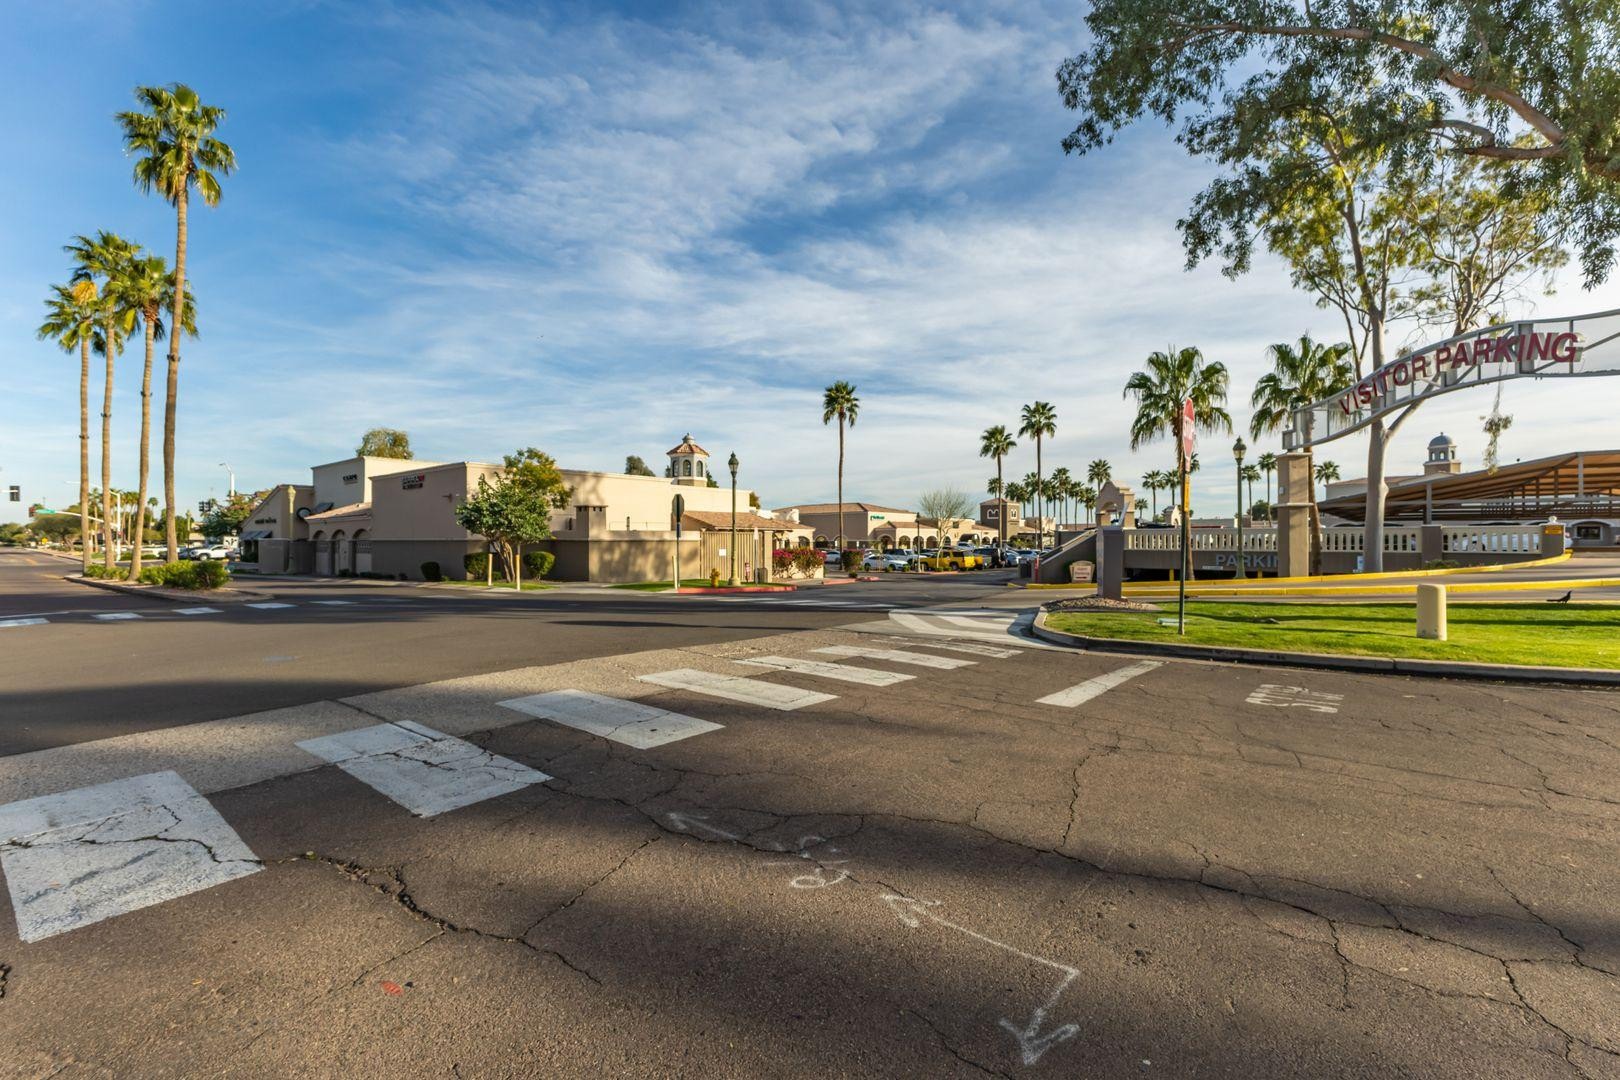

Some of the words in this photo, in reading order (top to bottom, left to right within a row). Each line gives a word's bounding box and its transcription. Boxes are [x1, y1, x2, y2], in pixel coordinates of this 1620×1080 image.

[1338, 355, 1428, 415] VISITOR
[1436, 332, 1578, 372] PARKING
[1216, 554, 1279, 568] PARKI
